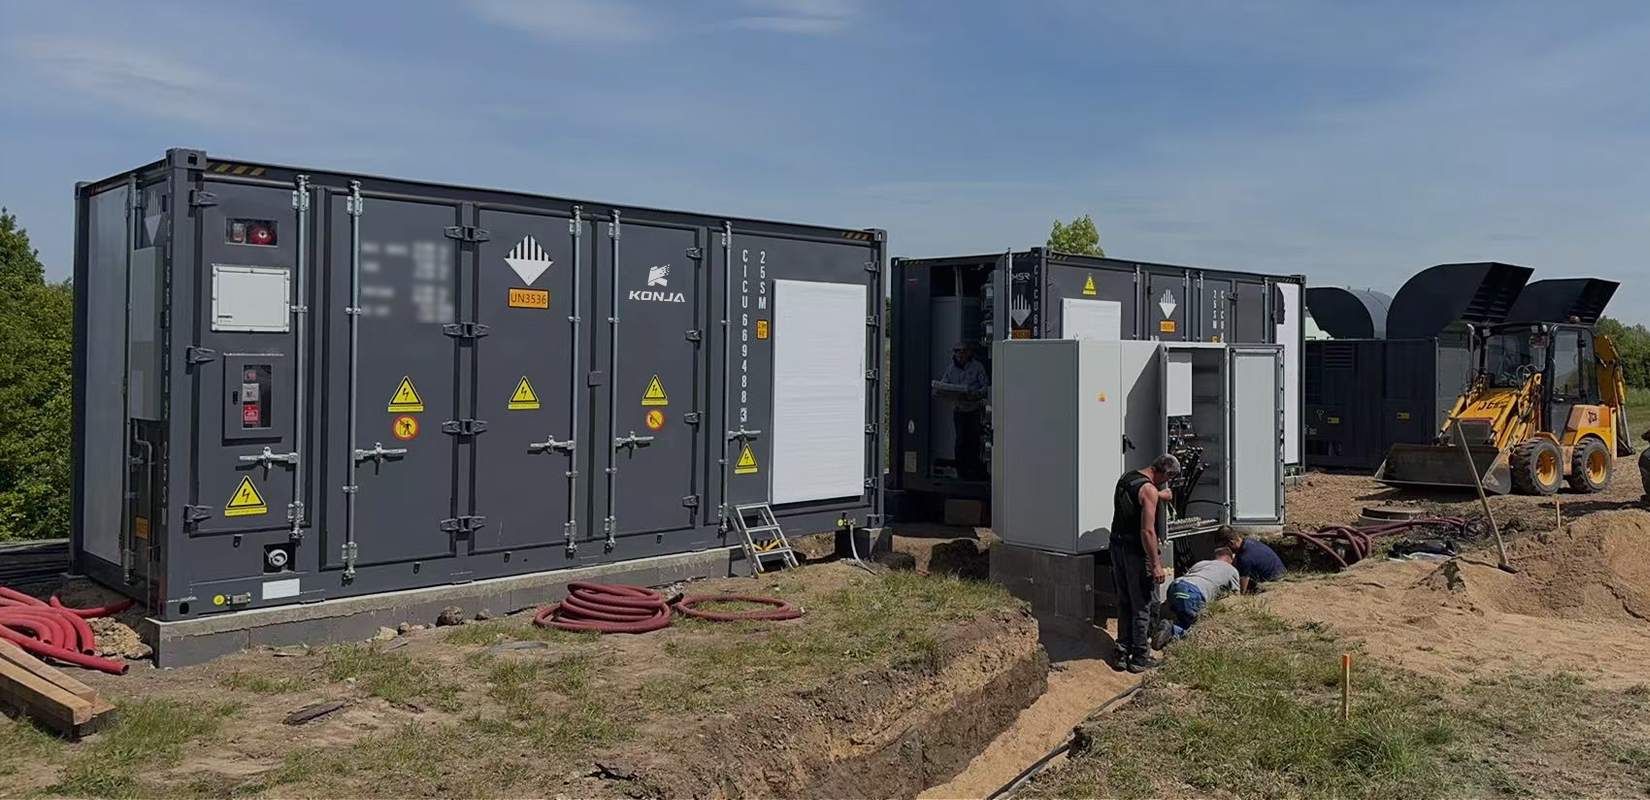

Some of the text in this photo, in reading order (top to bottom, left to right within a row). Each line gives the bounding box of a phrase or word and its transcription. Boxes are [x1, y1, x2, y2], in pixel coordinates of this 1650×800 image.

[758, 250, 767, 310] 25SM
[510, 293, 547, 305] UN3536
[628, 290, 687, 303] KONJA
